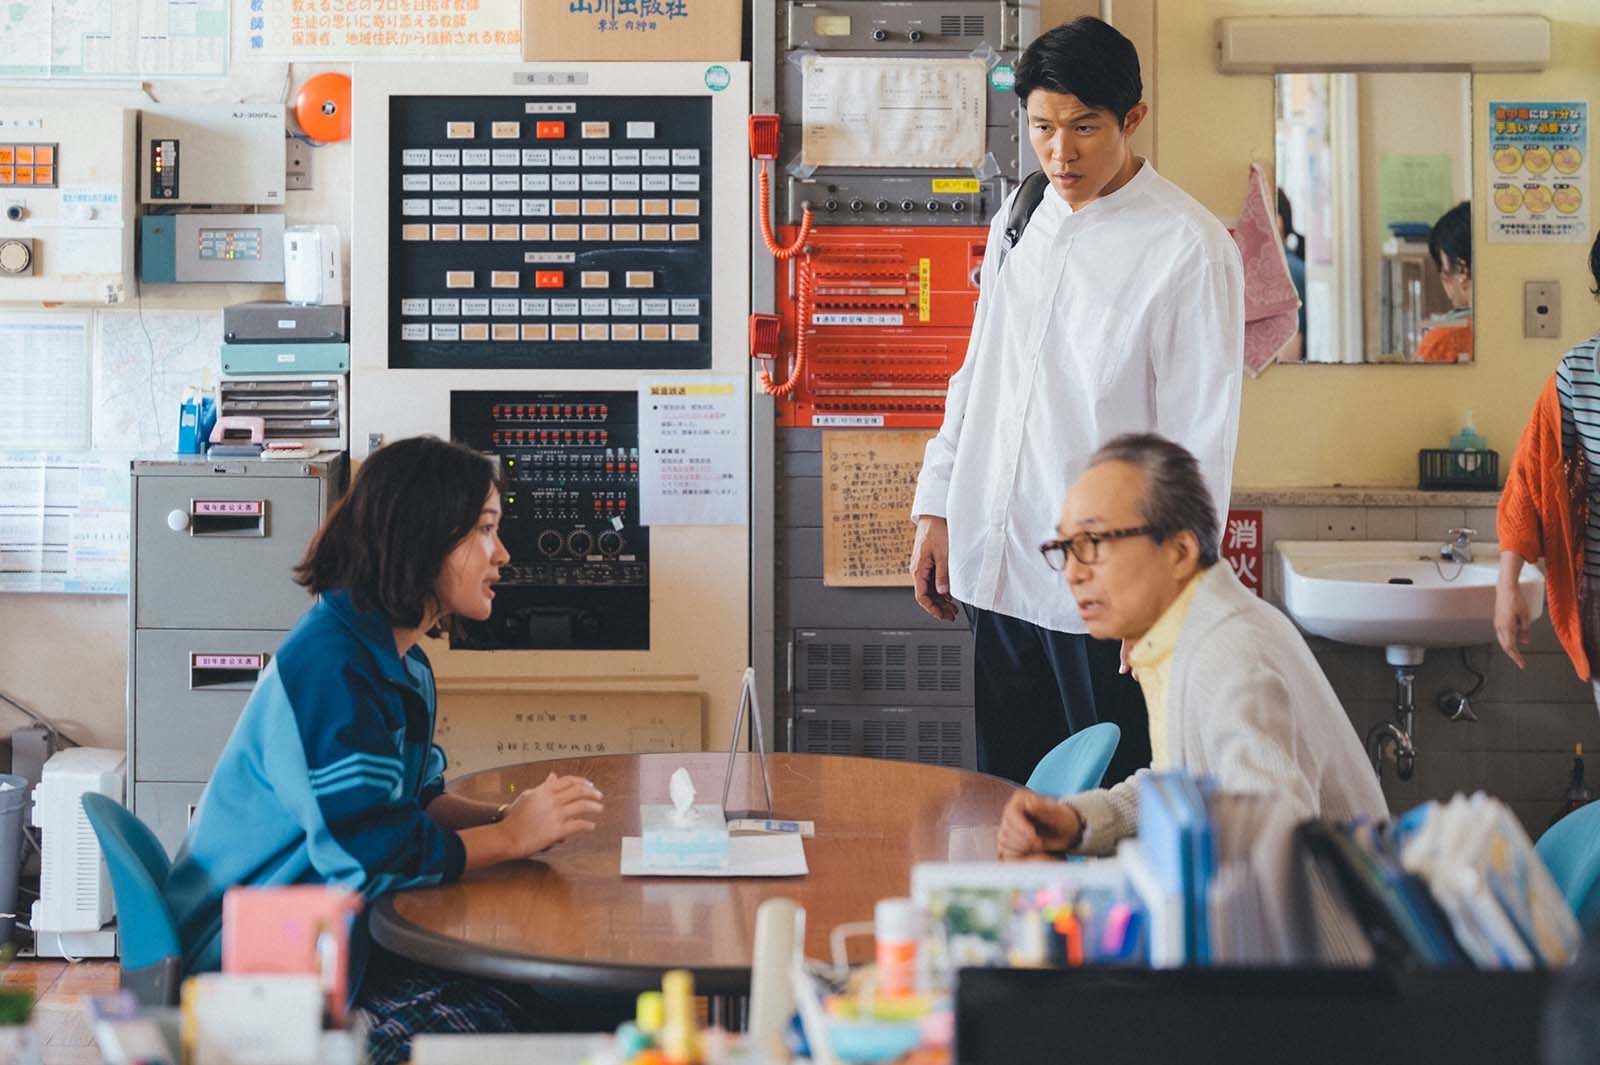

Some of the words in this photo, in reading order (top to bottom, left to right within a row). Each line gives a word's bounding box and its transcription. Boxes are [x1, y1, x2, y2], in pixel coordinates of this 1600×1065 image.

[569, 0, 688, 19] 山川出版社
